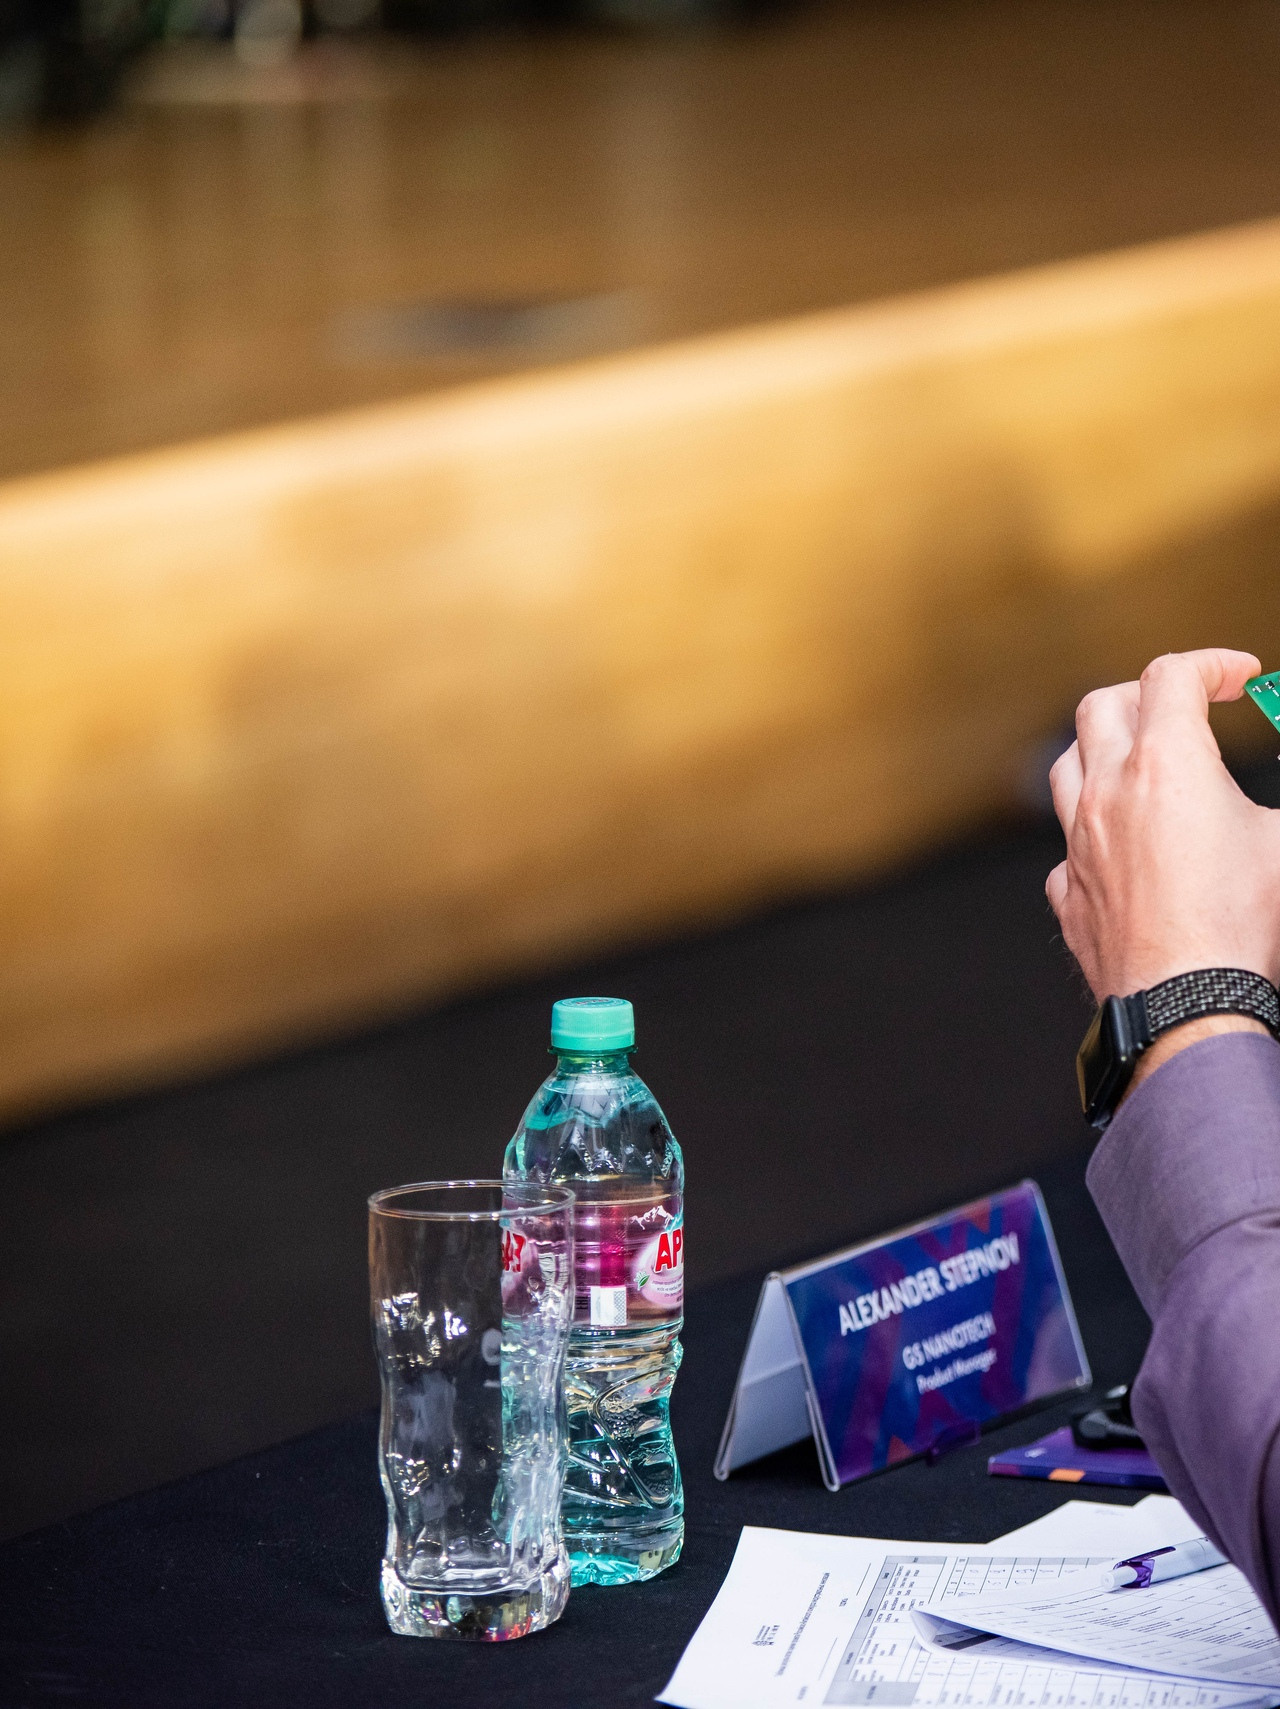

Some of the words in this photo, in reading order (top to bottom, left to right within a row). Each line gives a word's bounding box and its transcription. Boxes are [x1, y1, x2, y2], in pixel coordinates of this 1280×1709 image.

[655, 1227, 684, 1271] АР
[838, 1266, 945, 1336] ALEXANDER
[902, 1342, 926, 1370] GS
[922, 1312, 996, 1361] NANOTECH
[916, 1363, 953, 1394] Product
[952, 1348, 997, 1376] Manager
